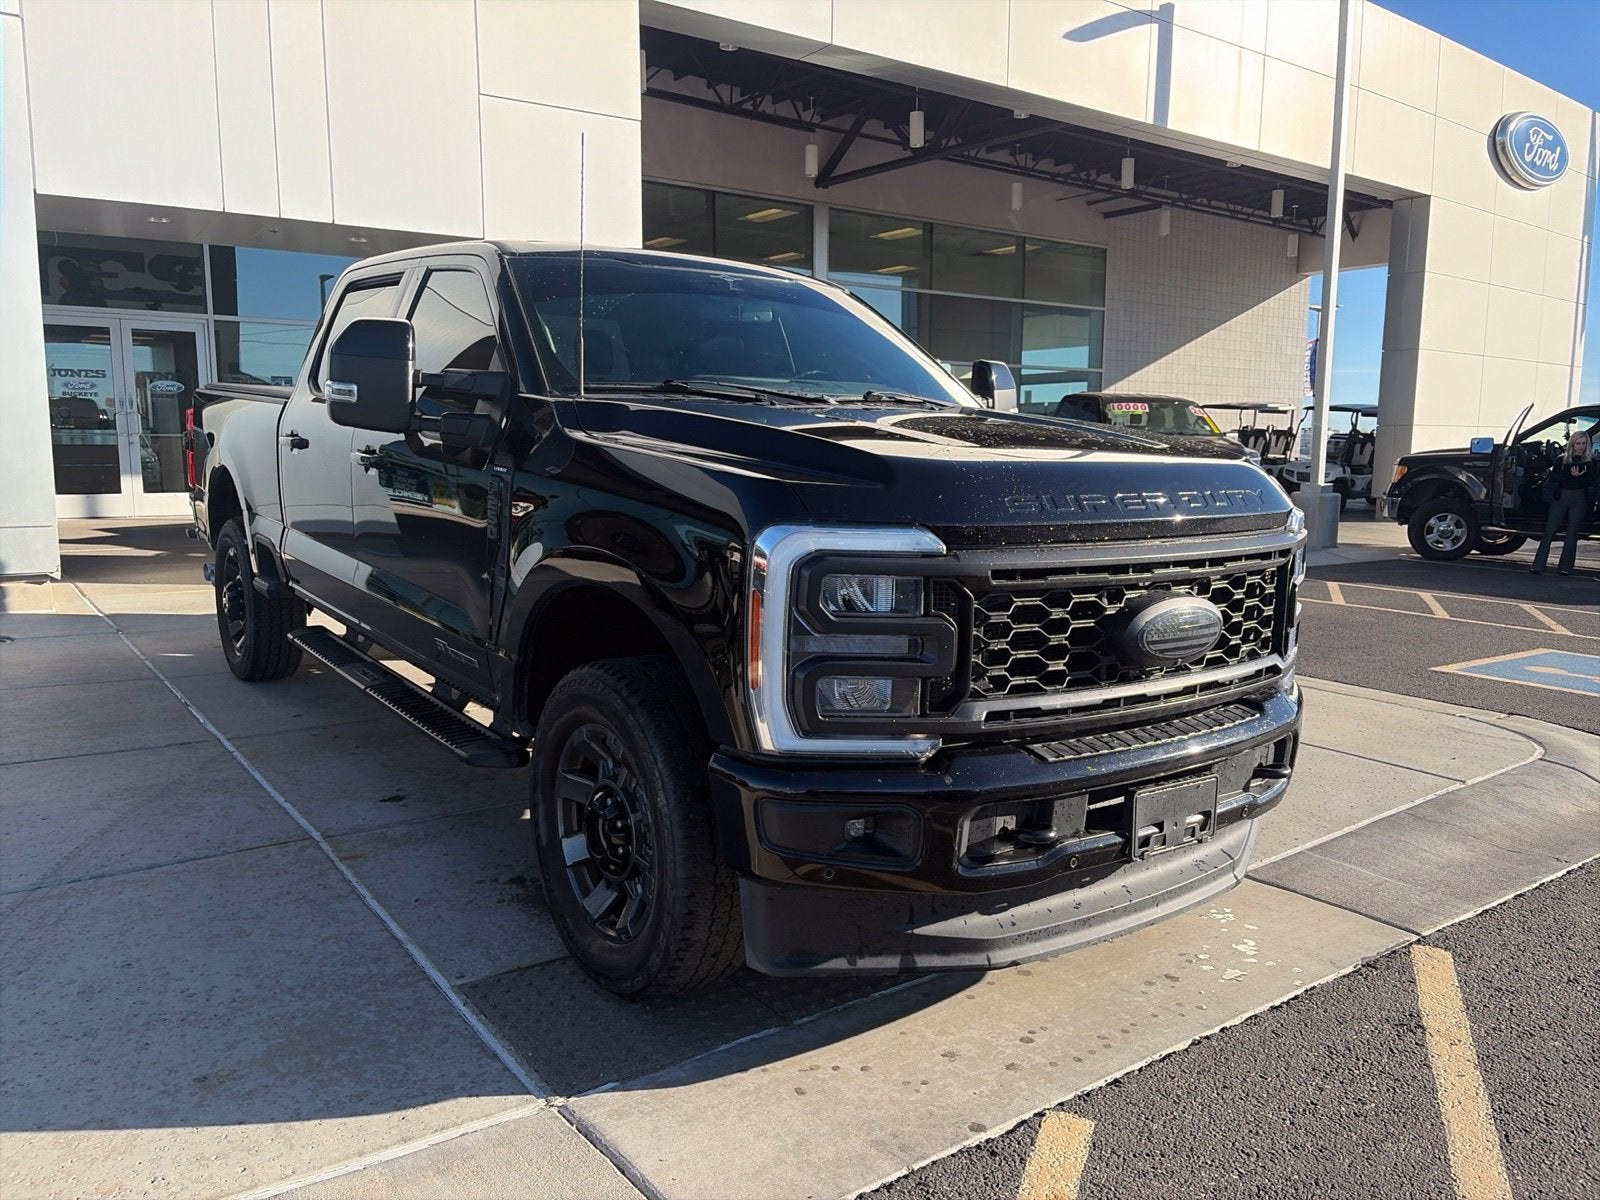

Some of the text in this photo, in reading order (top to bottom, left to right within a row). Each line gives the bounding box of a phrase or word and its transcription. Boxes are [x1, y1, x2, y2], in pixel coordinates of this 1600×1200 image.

[1524, 126, 1561, 172] Ford
[50, 367, 107, 379] JONES
[67, 380, 91, 389] Ford
[1004, 488, 1265, 514] SUPER DUTY
